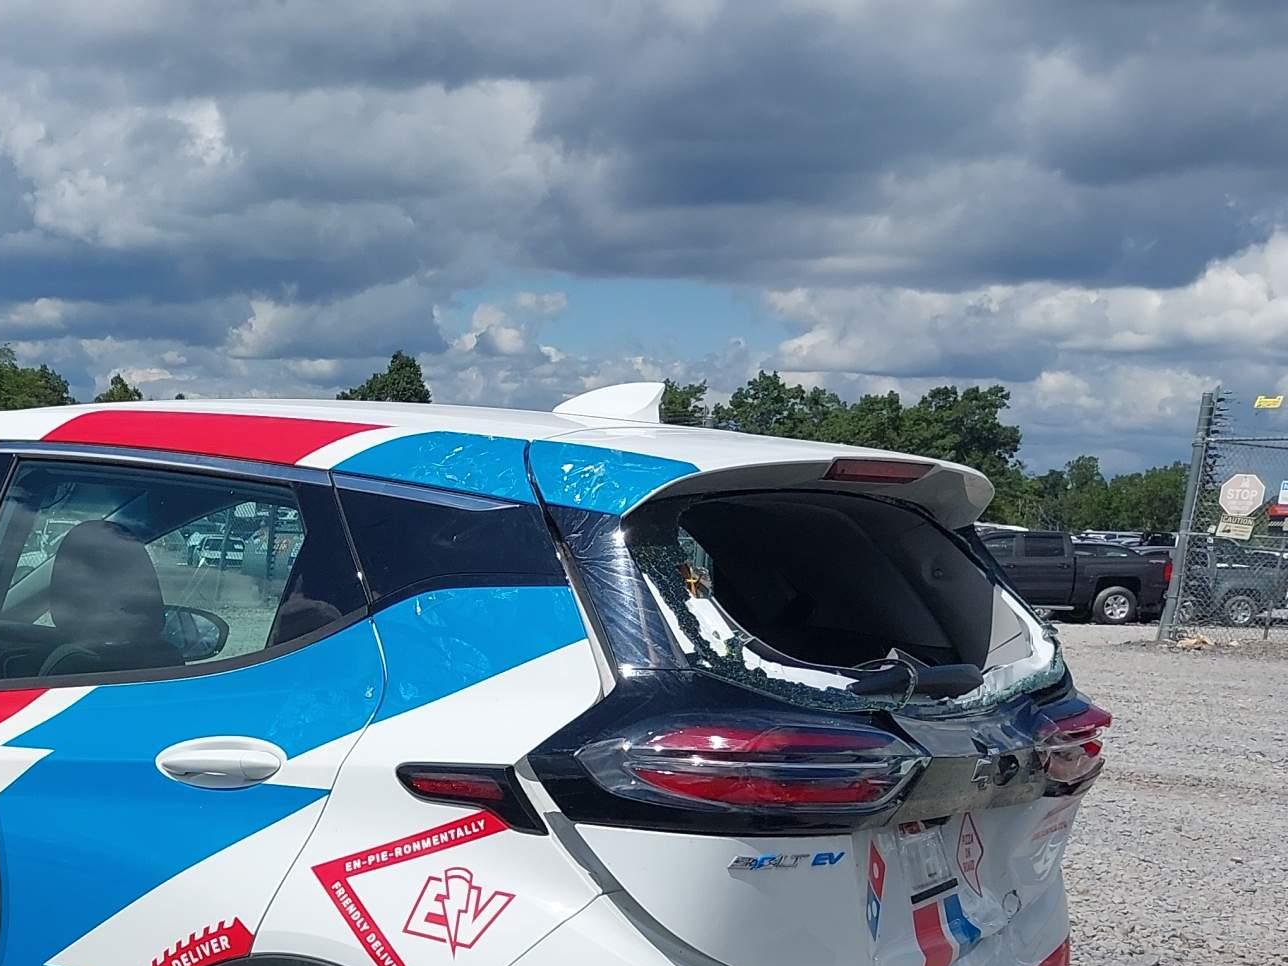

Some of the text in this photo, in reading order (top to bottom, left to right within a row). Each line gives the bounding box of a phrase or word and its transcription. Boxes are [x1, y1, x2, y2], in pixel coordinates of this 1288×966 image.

[1227, 488, 1258, 500] STOP
[1222, 515, 1253, 526] CAUTION
[344, 819, 486, 872] EN-PIE-RONMENTALLY
[811, 851, 846, 867] EV
[330, 881, 370, 932] FRIENDLY
[402, 867, 517, 960] EV
